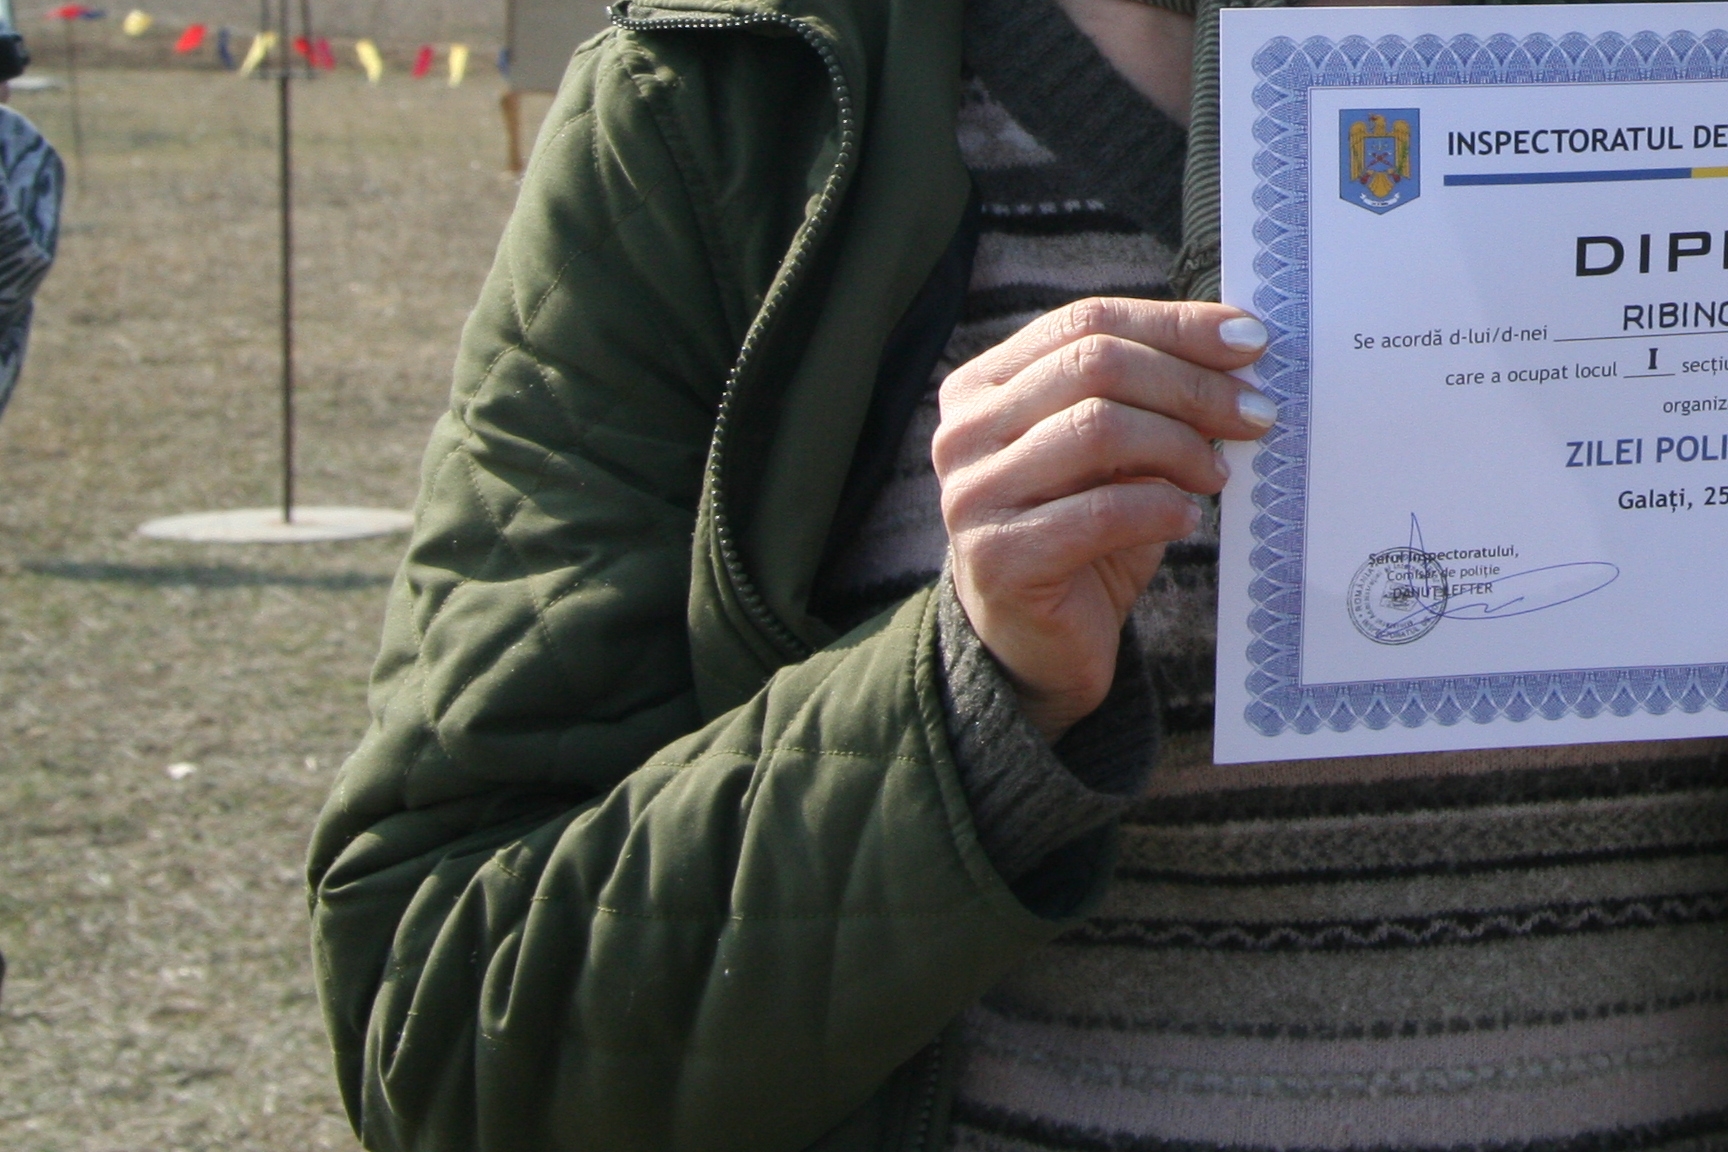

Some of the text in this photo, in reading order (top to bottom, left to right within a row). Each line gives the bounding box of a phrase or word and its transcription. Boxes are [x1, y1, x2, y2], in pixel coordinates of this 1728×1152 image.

[1448, 125, 1684, 156] INSPECTORATUL
[1353, 333, 1375, 350] Se
[1381, 328, 1443, 349] acordă
[1448, 325, 1547, 346] d-lui/d-nei
[1445, 372, 1485, 386] care
[1490, 371, 1501, 384] a
[1507, 365, 1569, 385] ocupat
[1575, 361, 1618, 379] locul
[1647, 347, 1659, 371] I
[1565, 438, 1643, 468] ZILEI
[1618, 487, 1693, 513] Galați,
[1460, 564, 1501, 579] poliție
